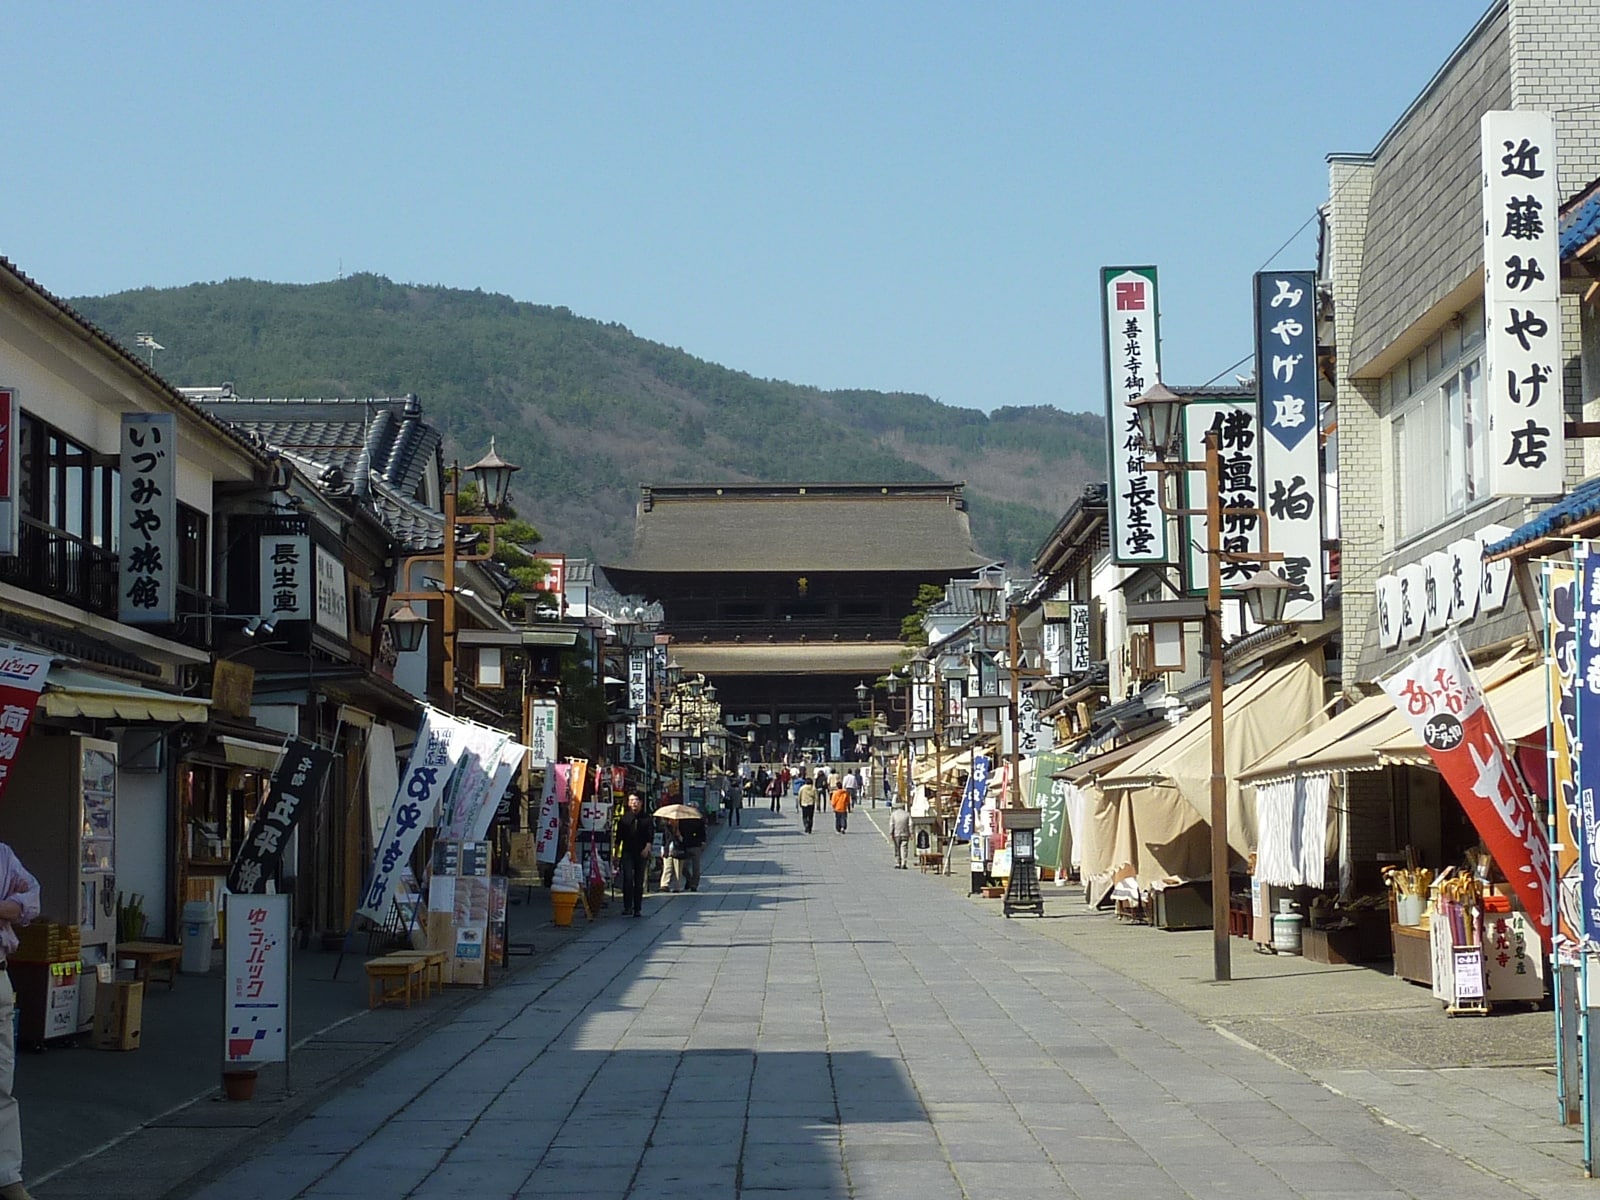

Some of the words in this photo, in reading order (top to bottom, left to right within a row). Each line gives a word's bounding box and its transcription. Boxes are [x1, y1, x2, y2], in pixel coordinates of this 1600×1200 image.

[1501, 139, 1551, 470] 近藤みやげ店
[1270, 279, 1306, 428] みやげ店
[126, 427, 163, 609] いづみや旅館
[1122, 475, 1156, 555] 長生堂
[1269, 475, 1315, 604] 柏屋
[270, 543, 300, 613] 長生堂
[1047, 767, 1065, 837] ばソフト
[246, 908, 271, 997] ゆうパック
[1494, 918, 1511, 968] 善光寺
